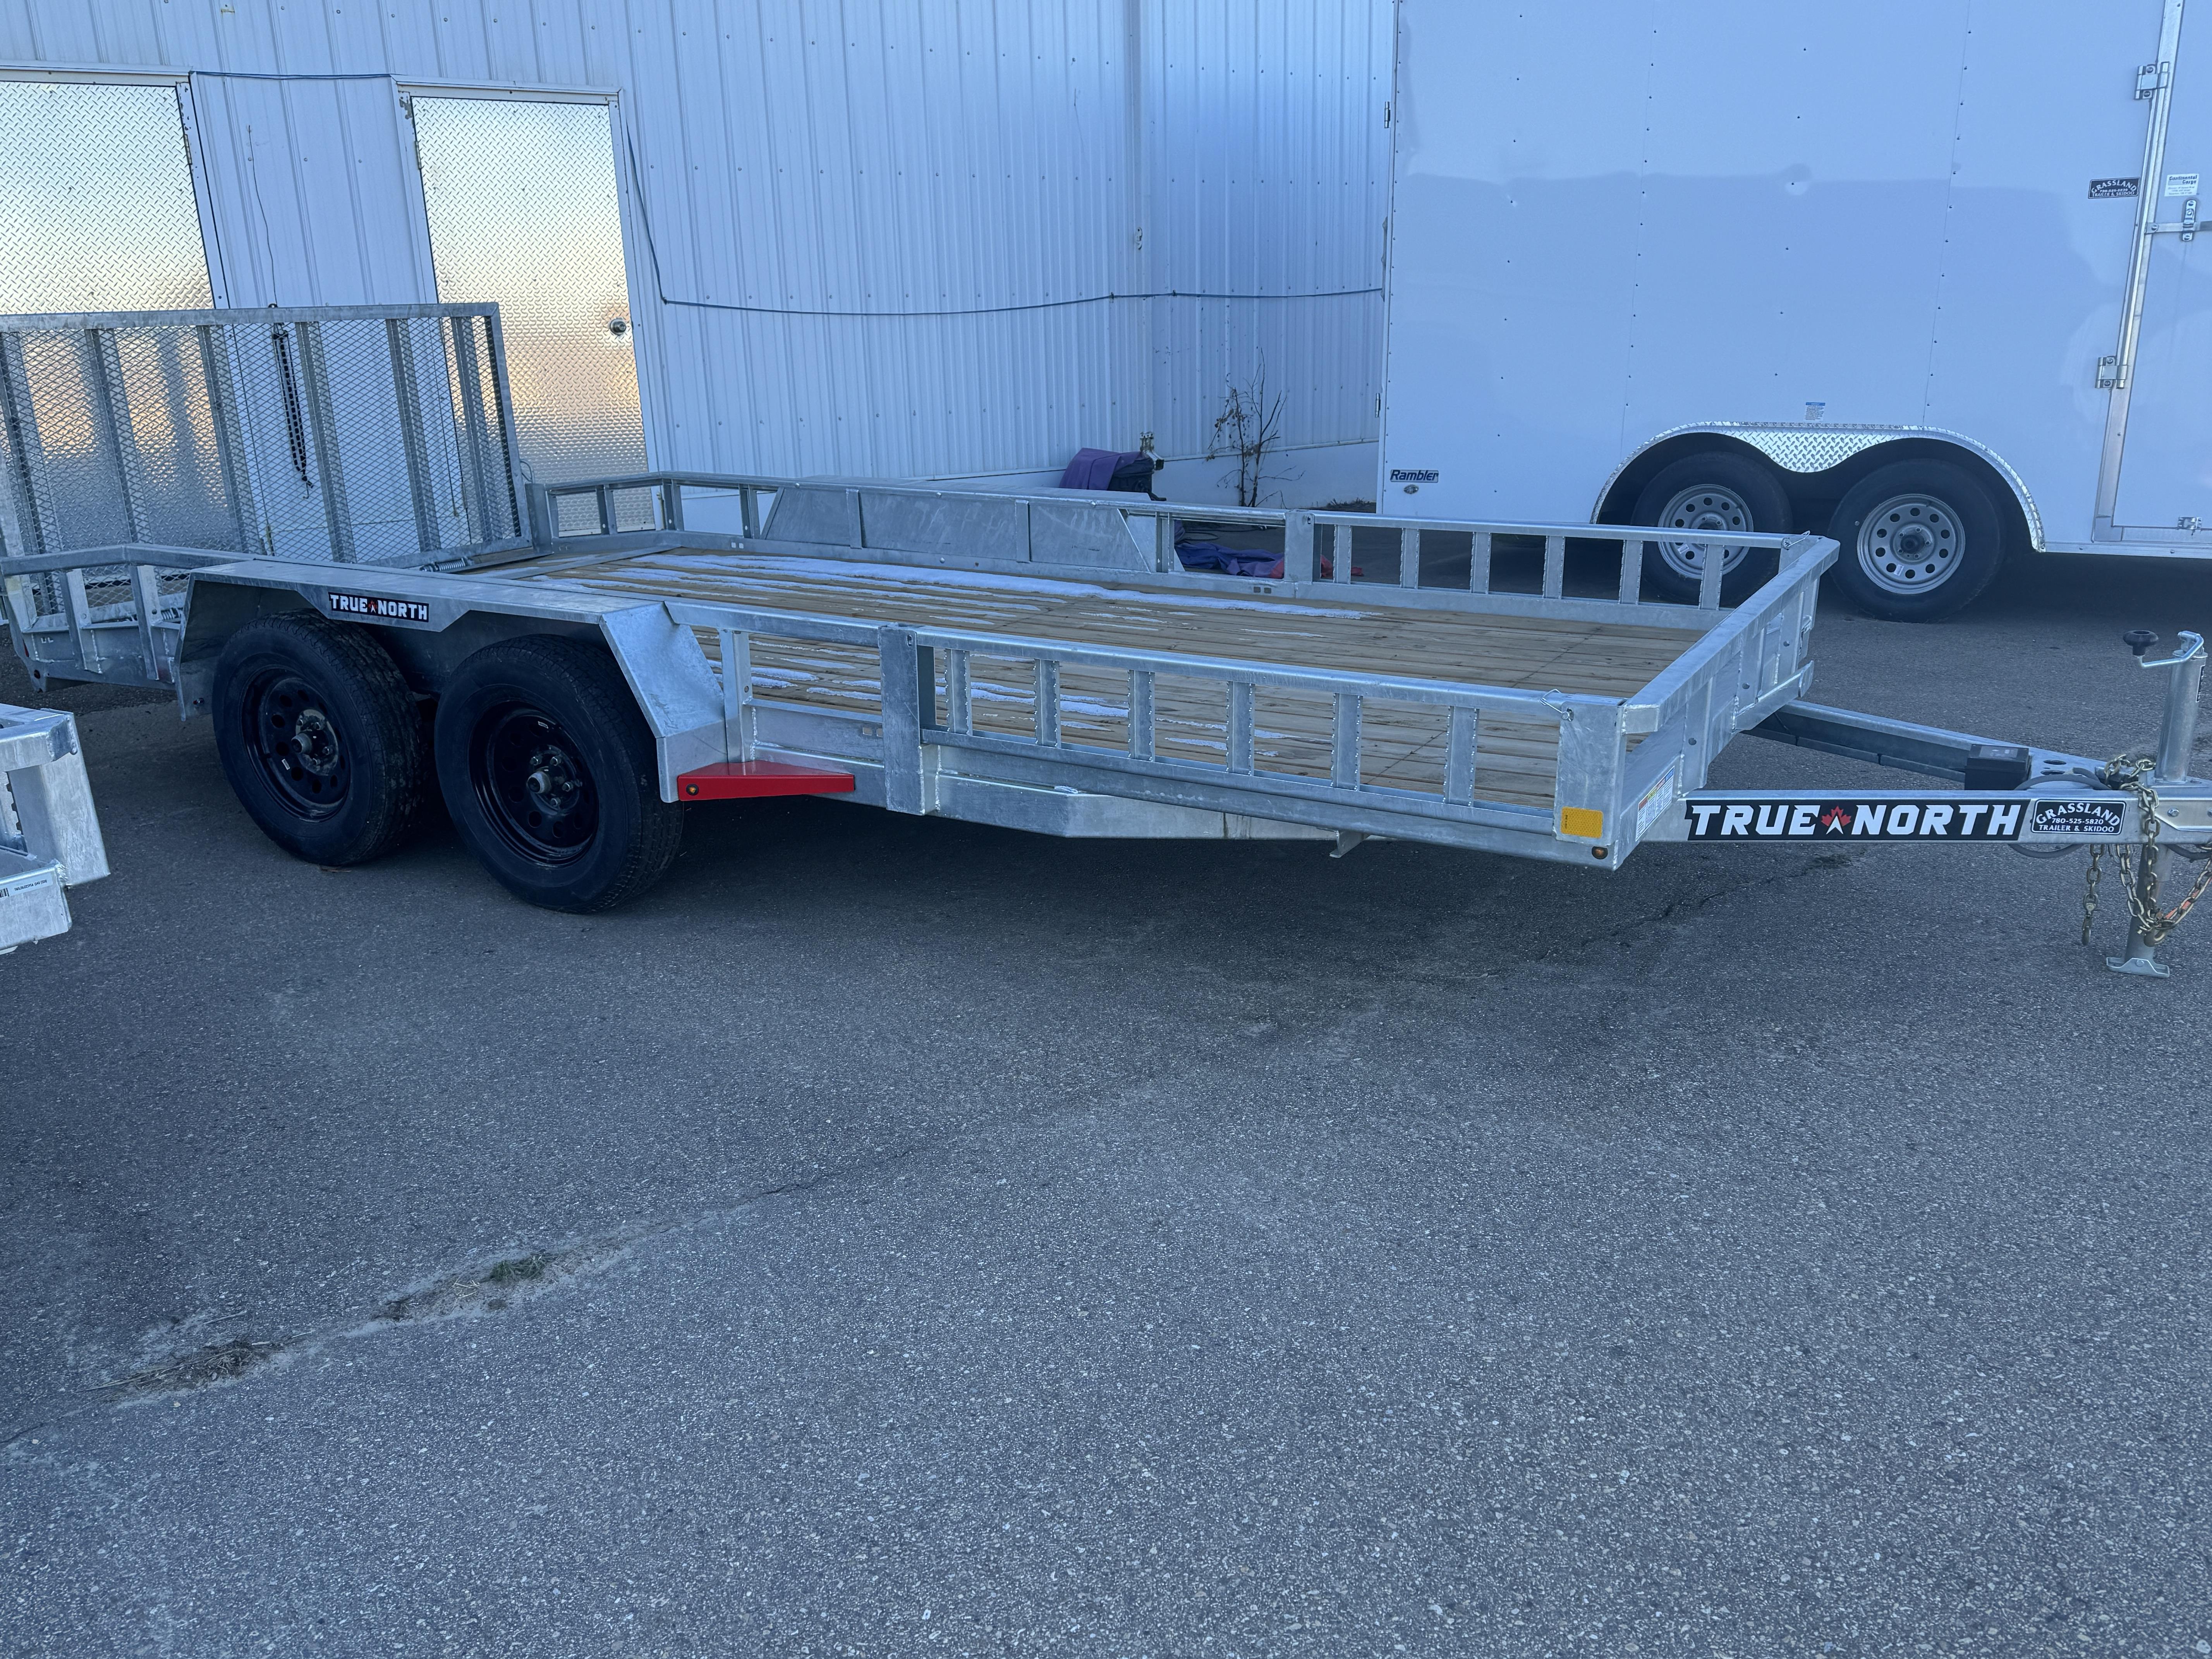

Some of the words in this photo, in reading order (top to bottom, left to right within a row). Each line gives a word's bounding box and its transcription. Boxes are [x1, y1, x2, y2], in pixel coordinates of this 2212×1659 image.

[2091, 180, 2136, 193] GRASSLAND
[1390, 469, 1439, 481] Rambler
[330, 594, 367, 612] TRUE
[377, 600, 427, 620] NORTH
[1692, 805, 1820, 835] TRUE
[1851, 805, 2021, 835] NORTH
[2036, 803, 2120, 826] GRASSLAND
